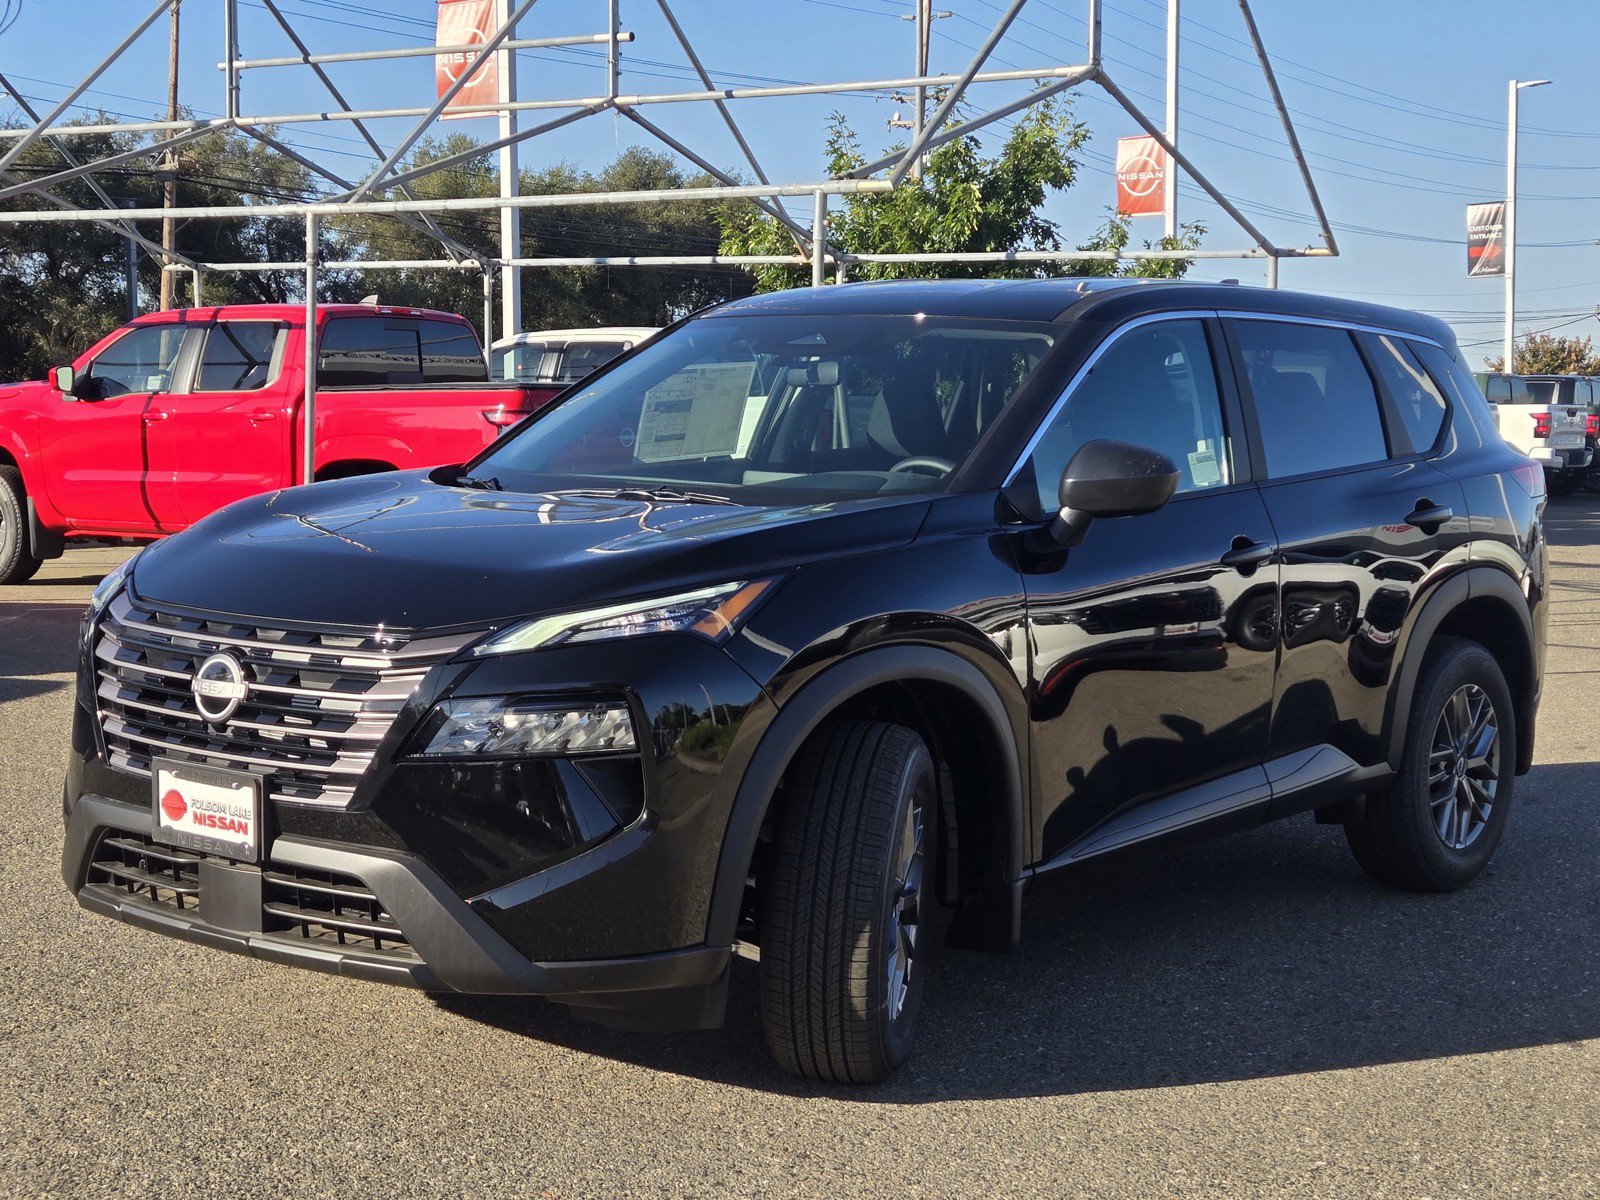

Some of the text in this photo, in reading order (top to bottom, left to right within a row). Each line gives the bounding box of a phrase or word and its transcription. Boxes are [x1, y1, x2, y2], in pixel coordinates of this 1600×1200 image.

[440, 51, 481, 63] NISS
[1118, 171, 1163, 180] NISSAN
[1469, 224, 1503, 232] CUSTOMER
[191, 679, 243, 697] NISSAN
[190, 797, 227, 814] FOLSOM
[228, 804, 252, 820] LAKE
[192, 811, 248, 835] NISSAN
[176, 832, 233, 855] NISSAN
